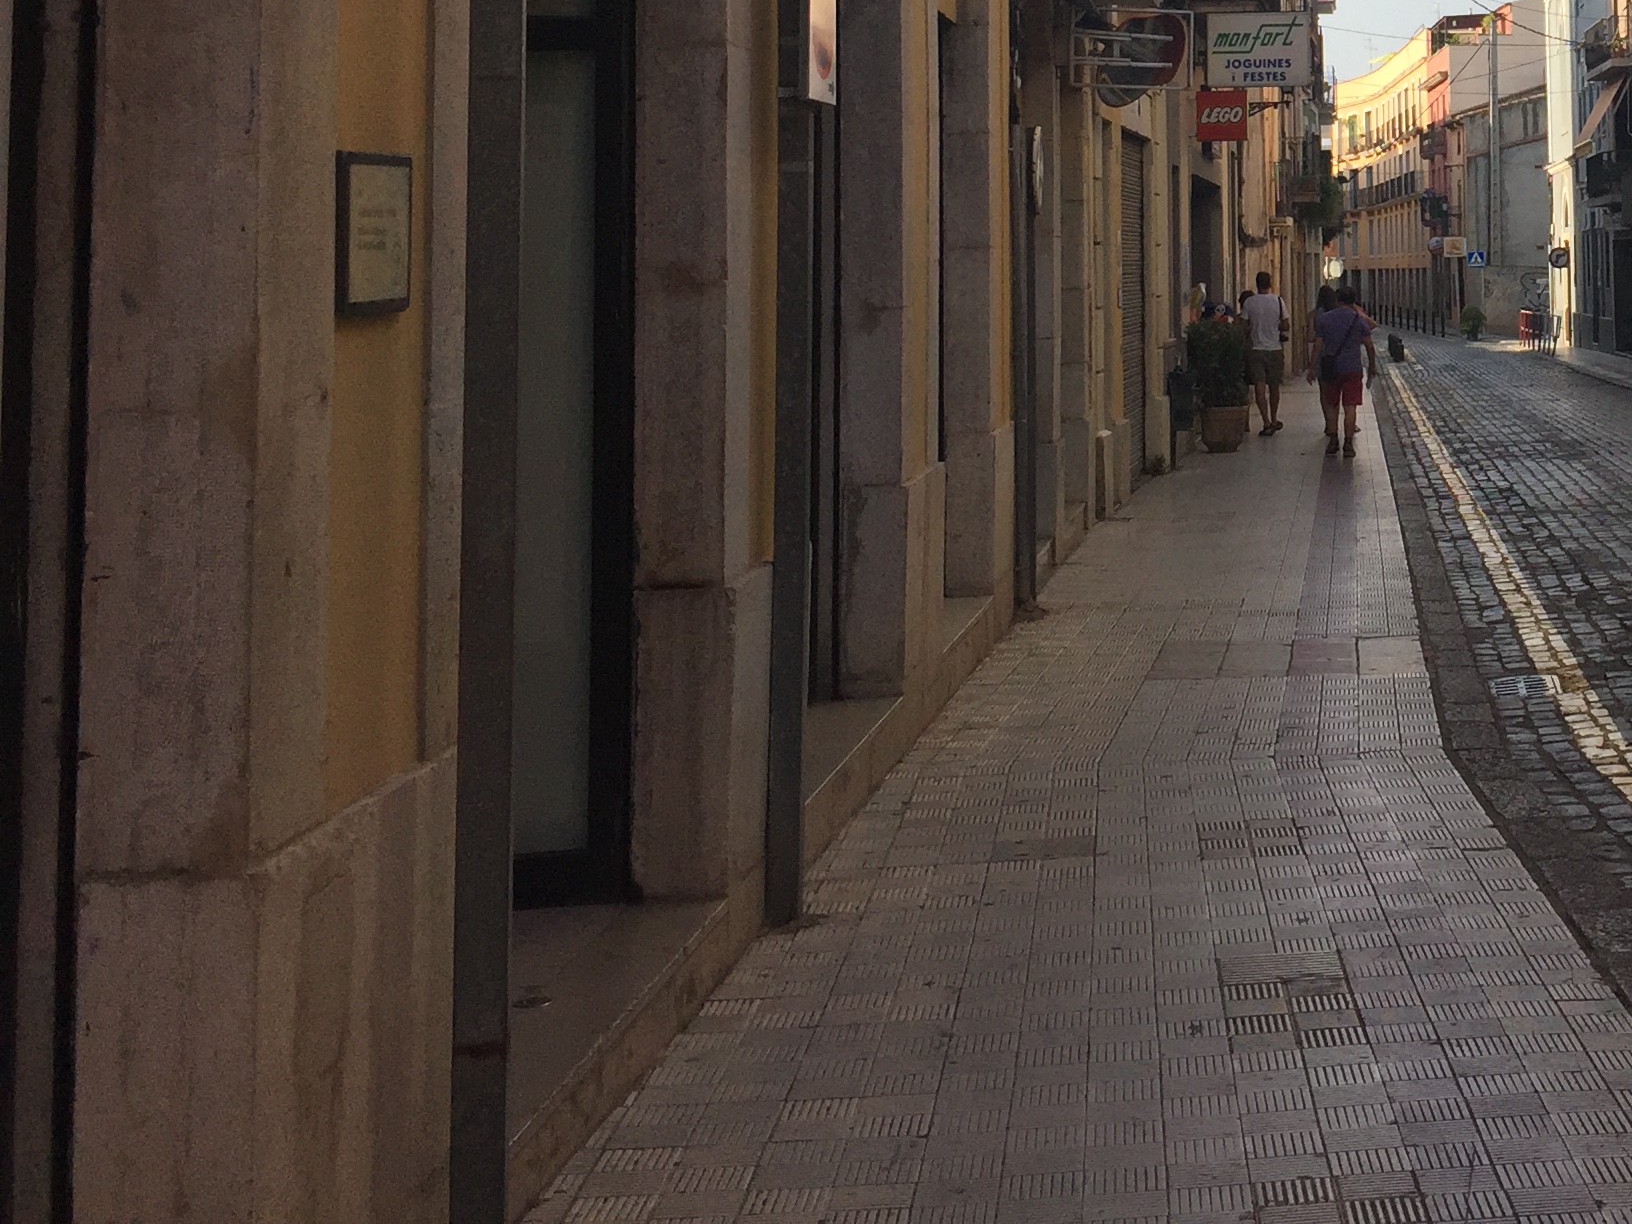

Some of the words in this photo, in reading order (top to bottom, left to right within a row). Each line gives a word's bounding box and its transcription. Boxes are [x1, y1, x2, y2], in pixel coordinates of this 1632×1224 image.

[1212, 16, 1304, 55] monfort
[1225, 58, 1292, 69] JOGUINES
[1243, 71, 1287, 82] FESTES
[1200, 106, 1243, 124] LEGO
